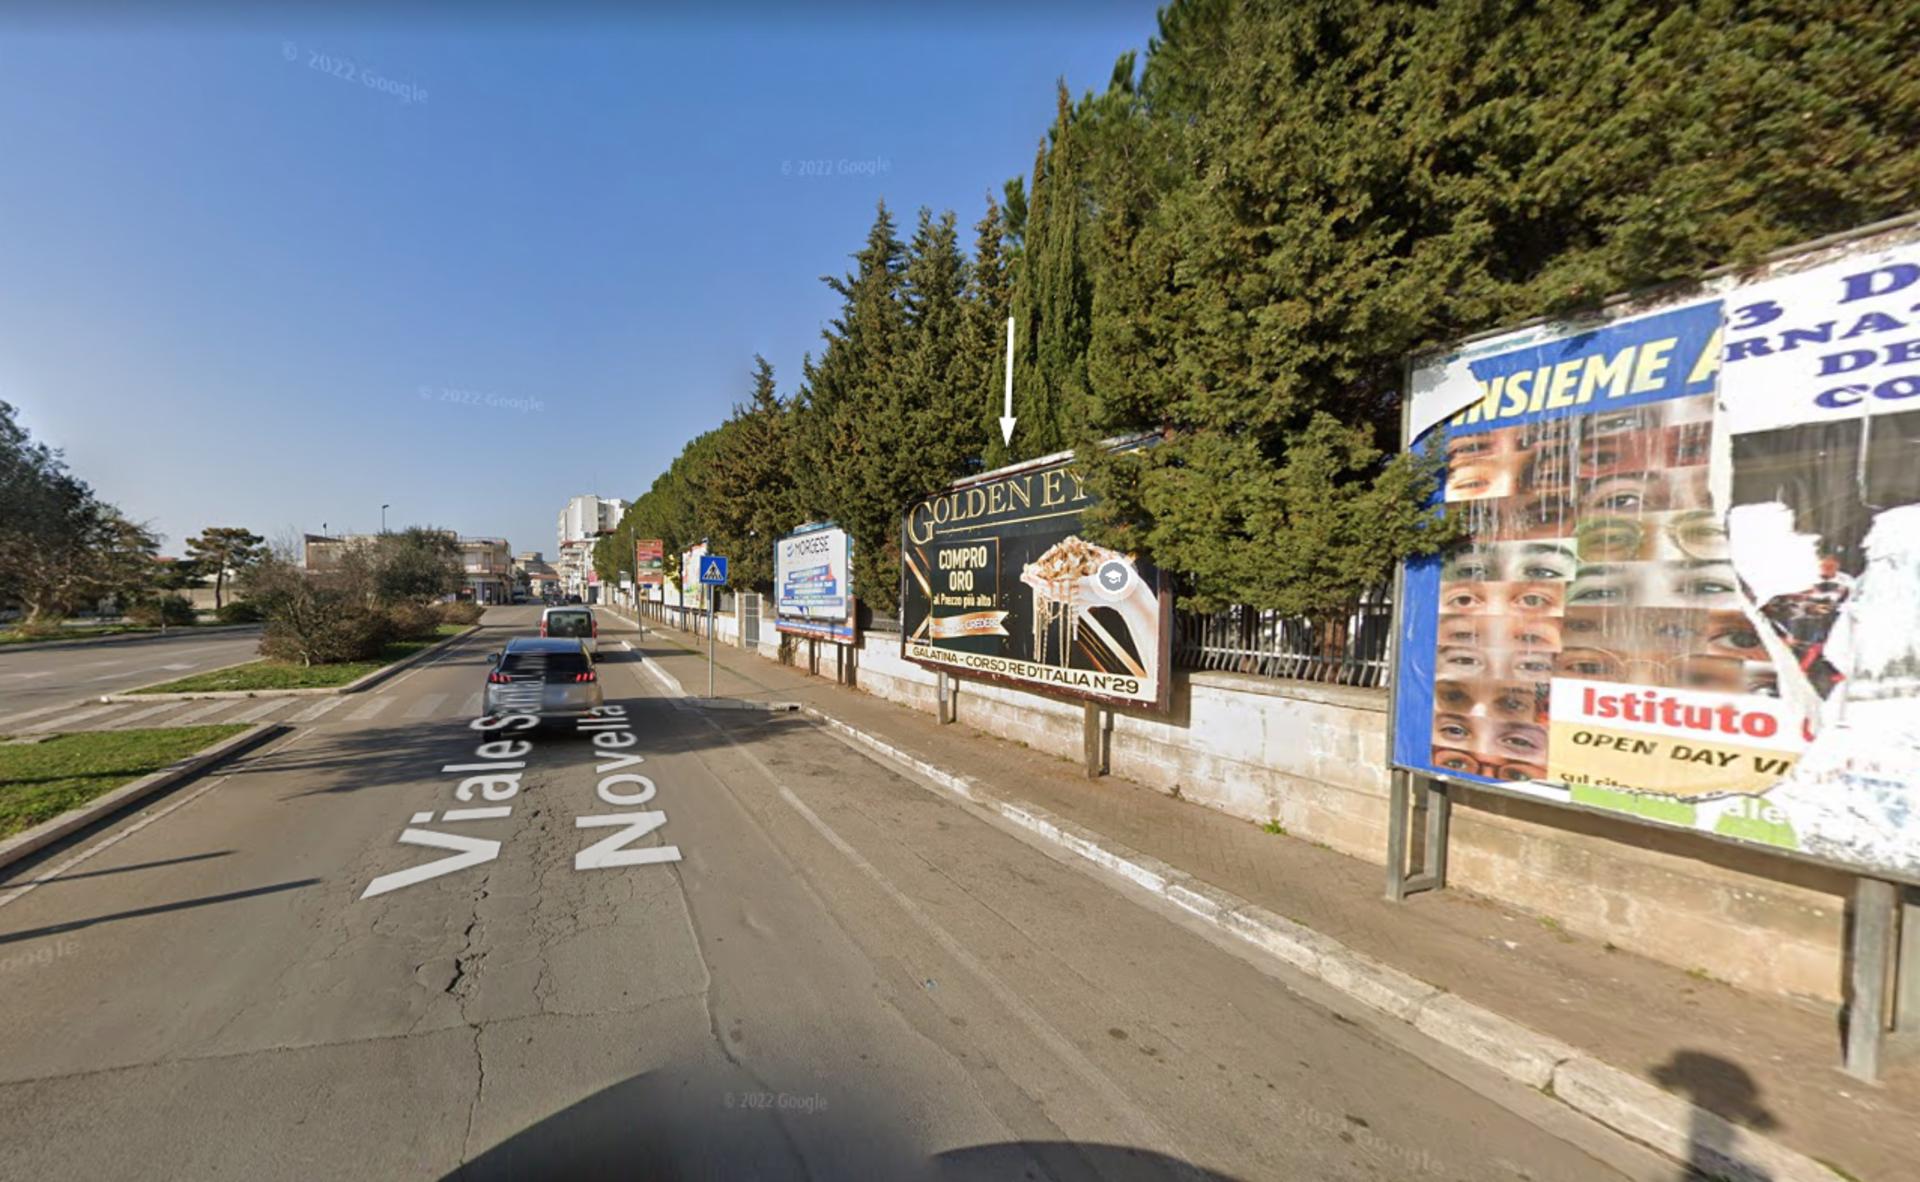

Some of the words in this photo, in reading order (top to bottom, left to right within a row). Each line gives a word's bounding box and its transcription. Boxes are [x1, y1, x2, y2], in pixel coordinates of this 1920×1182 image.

[1725, 305, 1920, 362] RNA
[907, 476, 1032, 545] GOLDEN
[1041, 468, 1088, 507] EY
[939, 545, 988, 570] COMPRO
[949, 570, 974, 591] ORO
[913, 646, 959, 663] GALATINA
[965, 655, 1007, 672] CORSO
[1583, 687, 1779, 738] Istituto
[1572, 731, 1657, 755] OPEN
[1670, 745, 1741, 767] DAY
